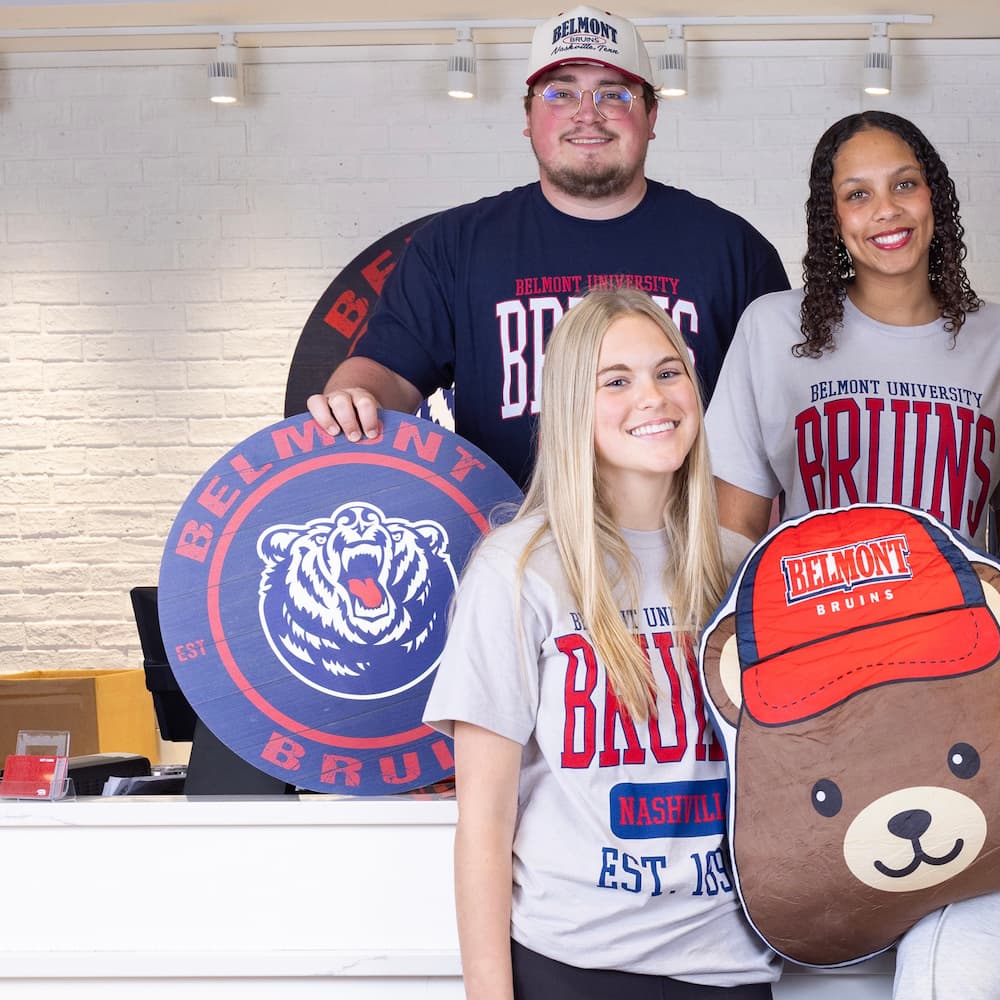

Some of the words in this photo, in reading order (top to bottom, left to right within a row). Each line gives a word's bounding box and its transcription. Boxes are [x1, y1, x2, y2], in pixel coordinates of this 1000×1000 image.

[552, 16, 618, 45] BELMONT
[515, 275, 582, 296] BELMONT
[587, 274, 680, 295] UNIVERSITY
[810, 379, 880, 403] BELMONT
[886, 380, 983, 408] UNIVERSITY
[795, 397, 996, 538] BRUINS
[786, 537, 912, 599] BELMONT
[816, 589, 894, 616] BRUINS
[175, 639, 207, 662] EST
[619, 792, 725, 826] NASHVILL
[597, 847, 676, 896] EST.
